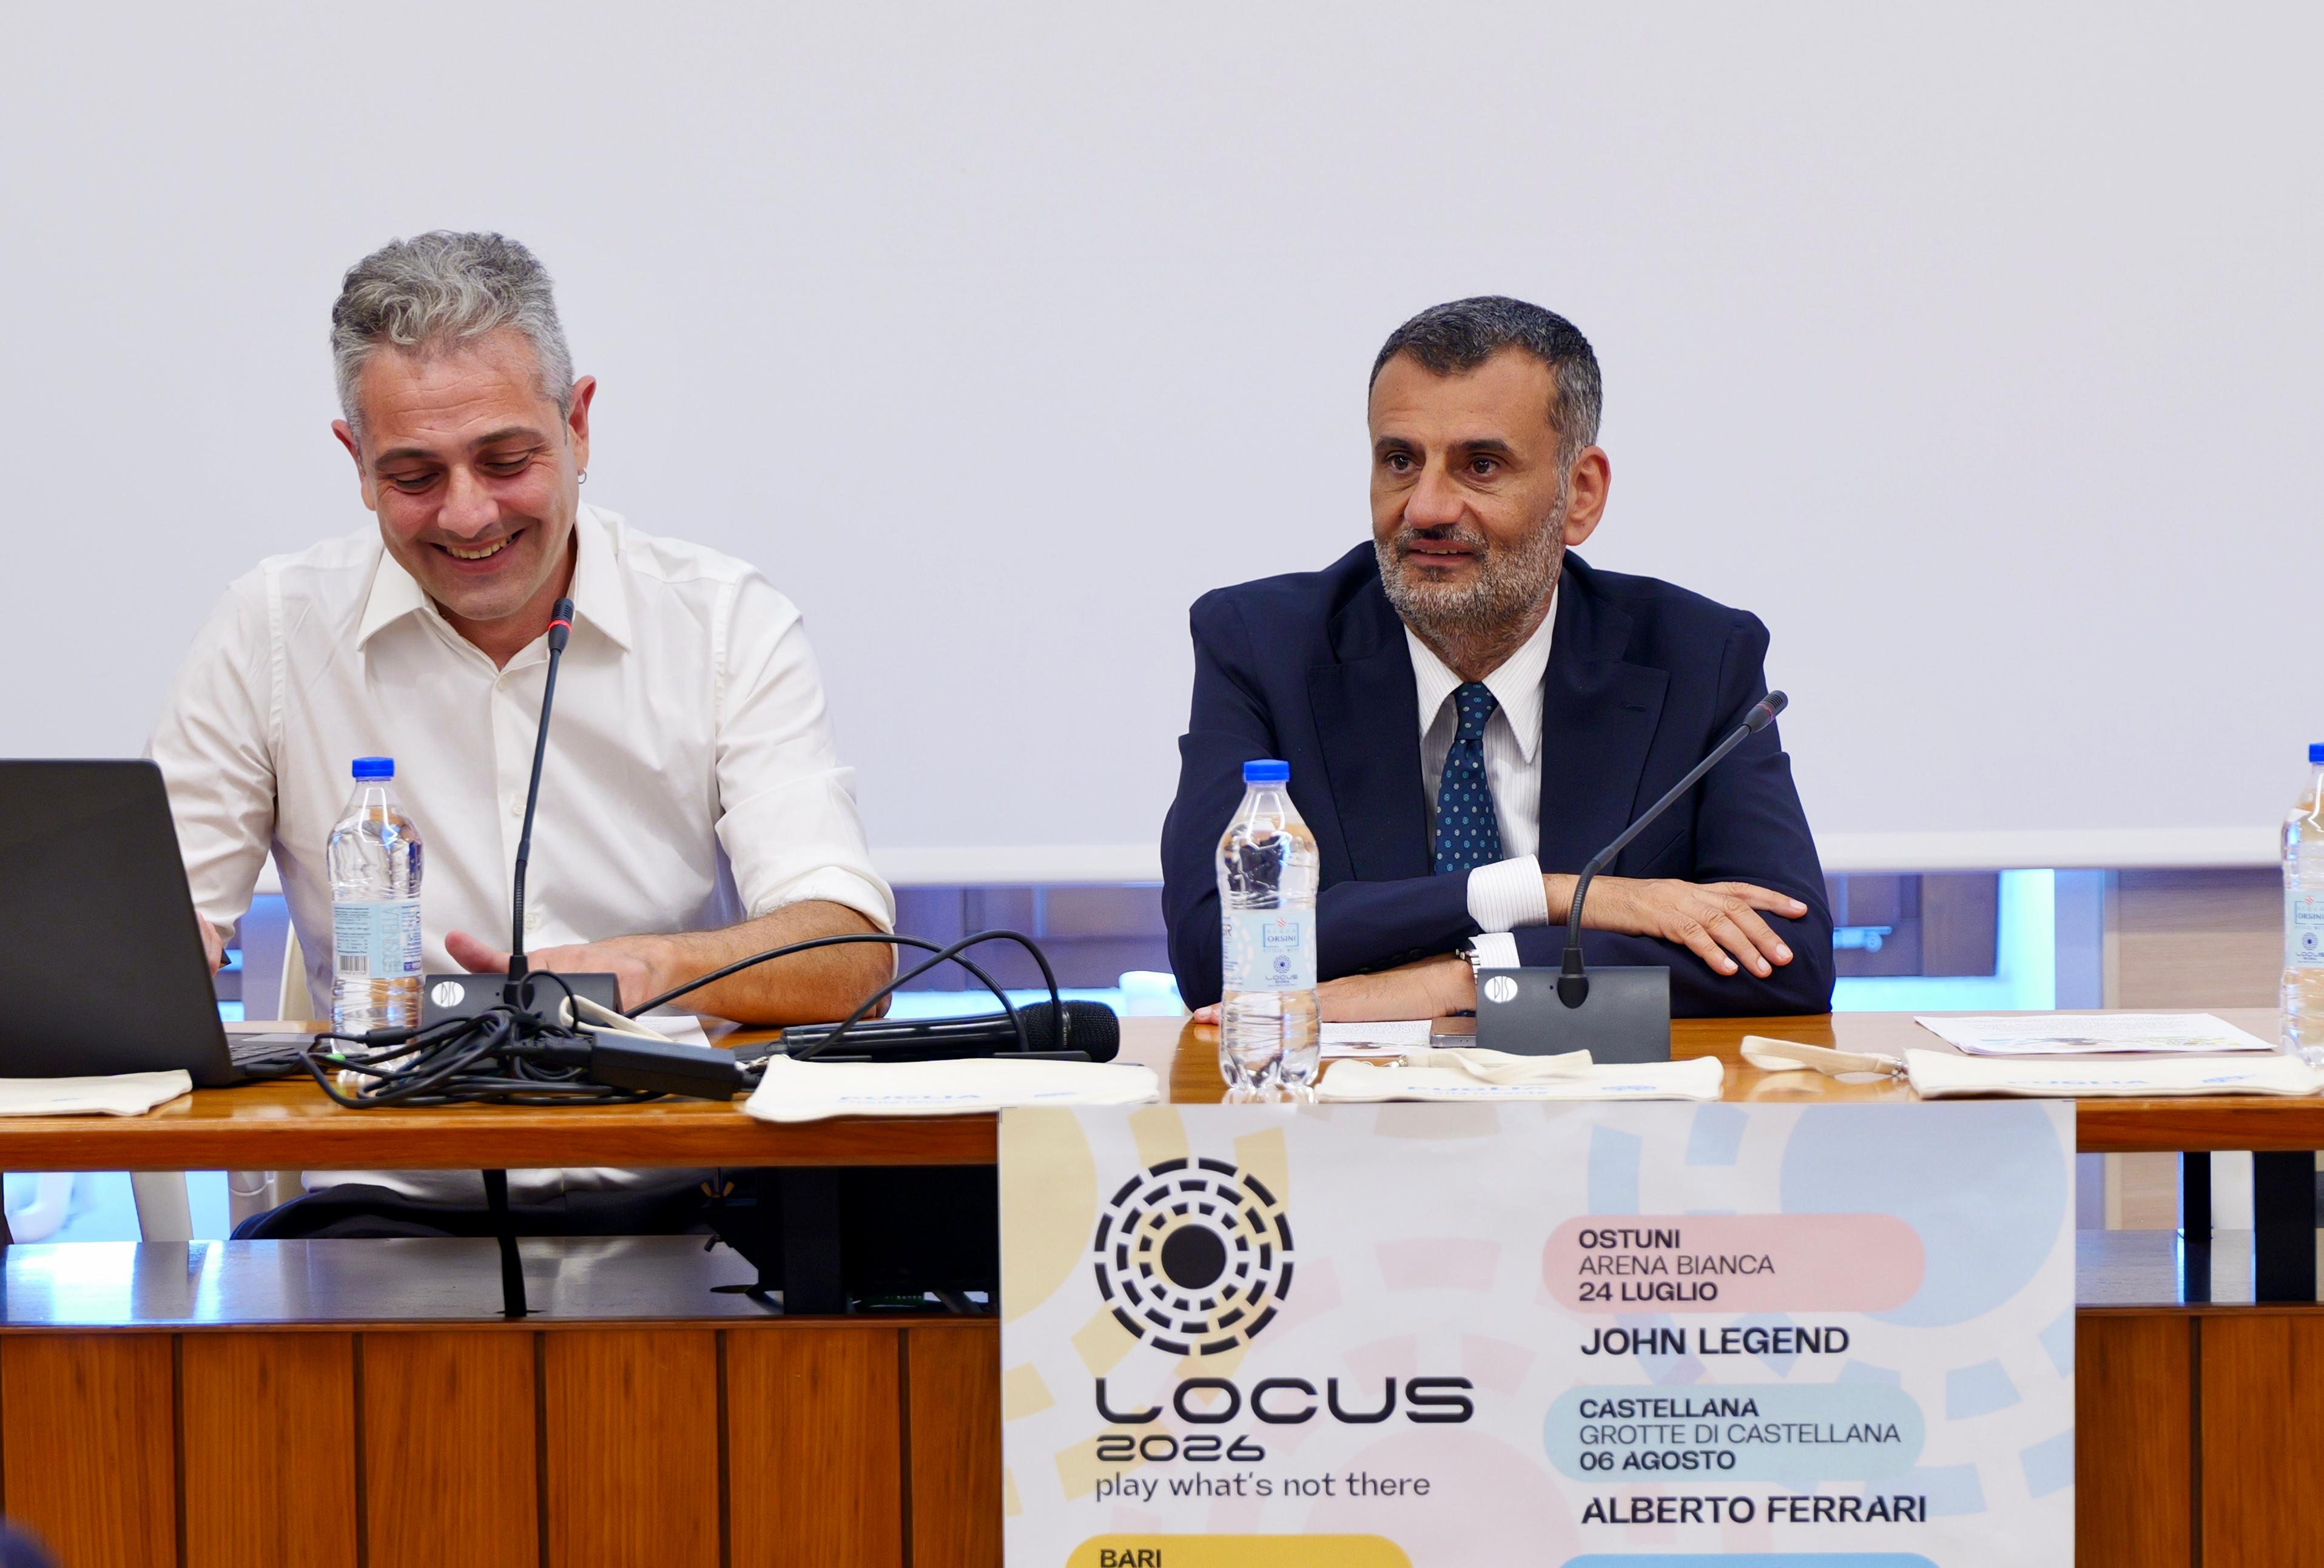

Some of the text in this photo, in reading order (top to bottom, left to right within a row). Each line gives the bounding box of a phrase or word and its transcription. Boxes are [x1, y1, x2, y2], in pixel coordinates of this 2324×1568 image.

[1578, 1229, 1680, 1249] OSTUNI
[1578, 1254, 1775, 1275] ARENA BIANCA
[1579, 1282, 1718, 1302] 24 LUGLIO
[1581, 1327, 1850, 1356] JOHN LEGEND
[1096, 1377, 1474, 1425] LOCUS
[1580, 1398, 1760, 1419] CASTELLANA
[1580, 1424, 1901, 1445] GROTTE DI CASTELLANA
[1096, 1435, 1265, 1462] 2026
[1580, 1450, 1736, 1471] 06 AGOSTO
[1096, 1472, 1430, 1502] play what's not there
[1581, 1495, 1926, 1524] ALBERTO FERRARI
[1100, 1549, 1162, 1568] BARI
